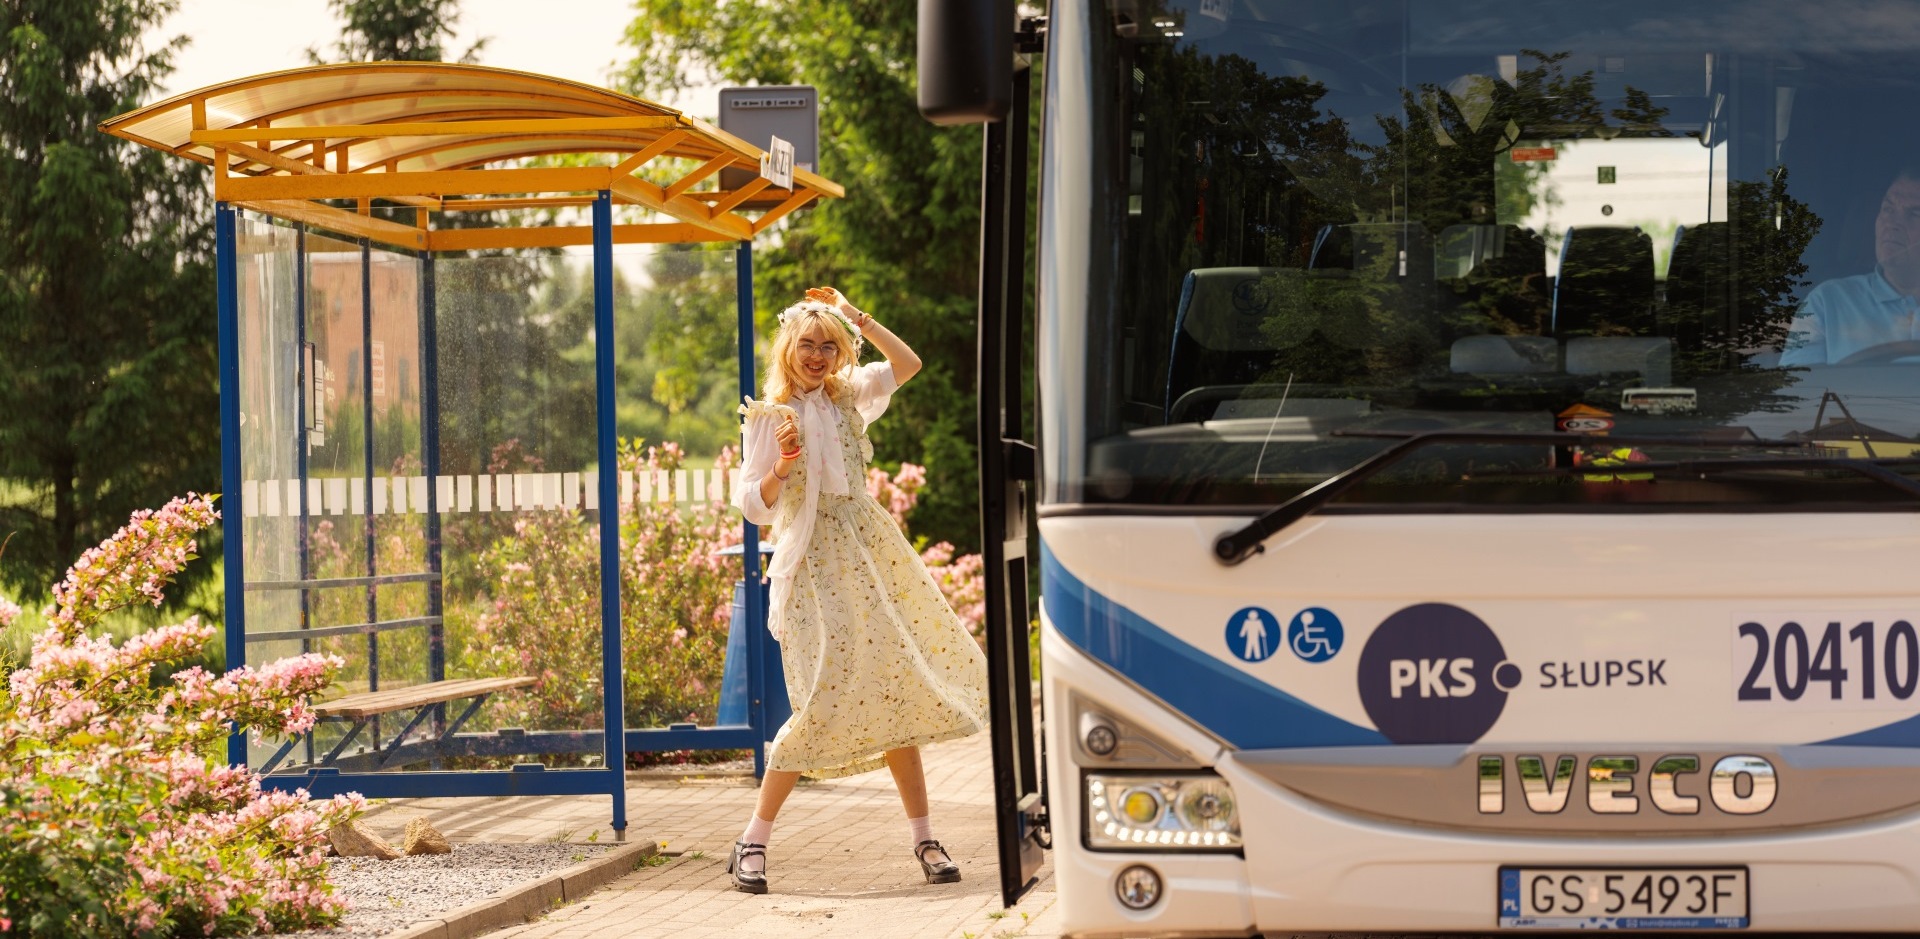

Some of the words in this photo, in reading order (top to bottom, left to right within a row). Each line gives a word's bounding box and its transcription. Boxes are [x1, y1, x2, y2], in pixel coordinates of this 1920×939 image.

[1390, 658, 1476, 698] PKS
[1540, 659, 1667, 688] SŁUPSK
[1738, 620, 1919, 701] 20410
[1477, 754, 1778, 815] IVECO
[1503, 899, 1518, 911] PL
[1531, 875, 1584, 914] GS
[1604, 875, 1736, 914] 5493F
